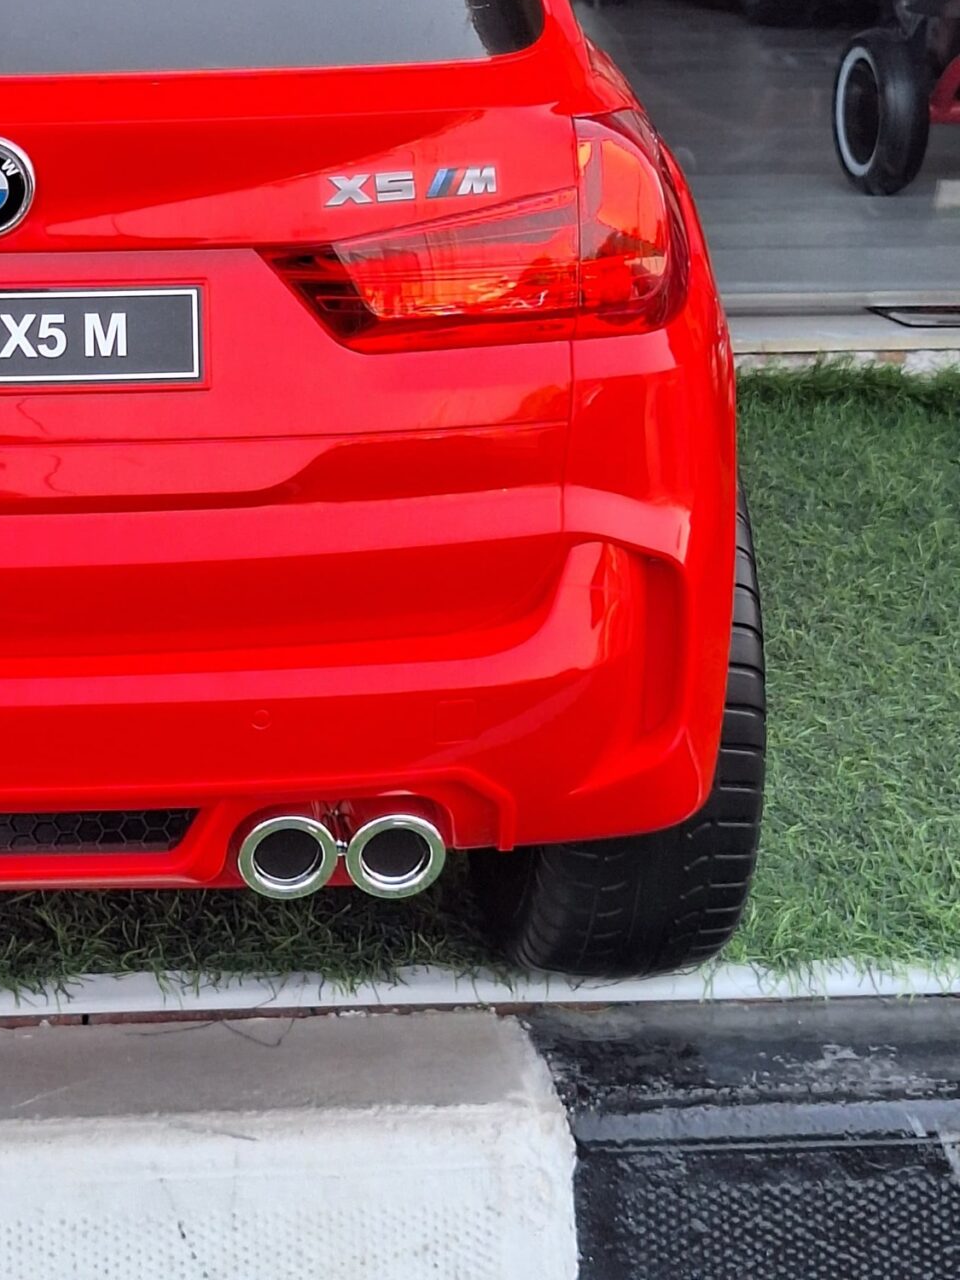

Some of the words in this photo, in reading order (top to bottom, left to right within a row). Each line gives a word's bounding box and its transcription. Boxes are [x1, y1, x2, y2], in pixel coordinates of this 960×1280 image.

[324, 171, 416, 207] X5
[0, 313, 68, 359] X5
[84, 312, 128, 357] M
